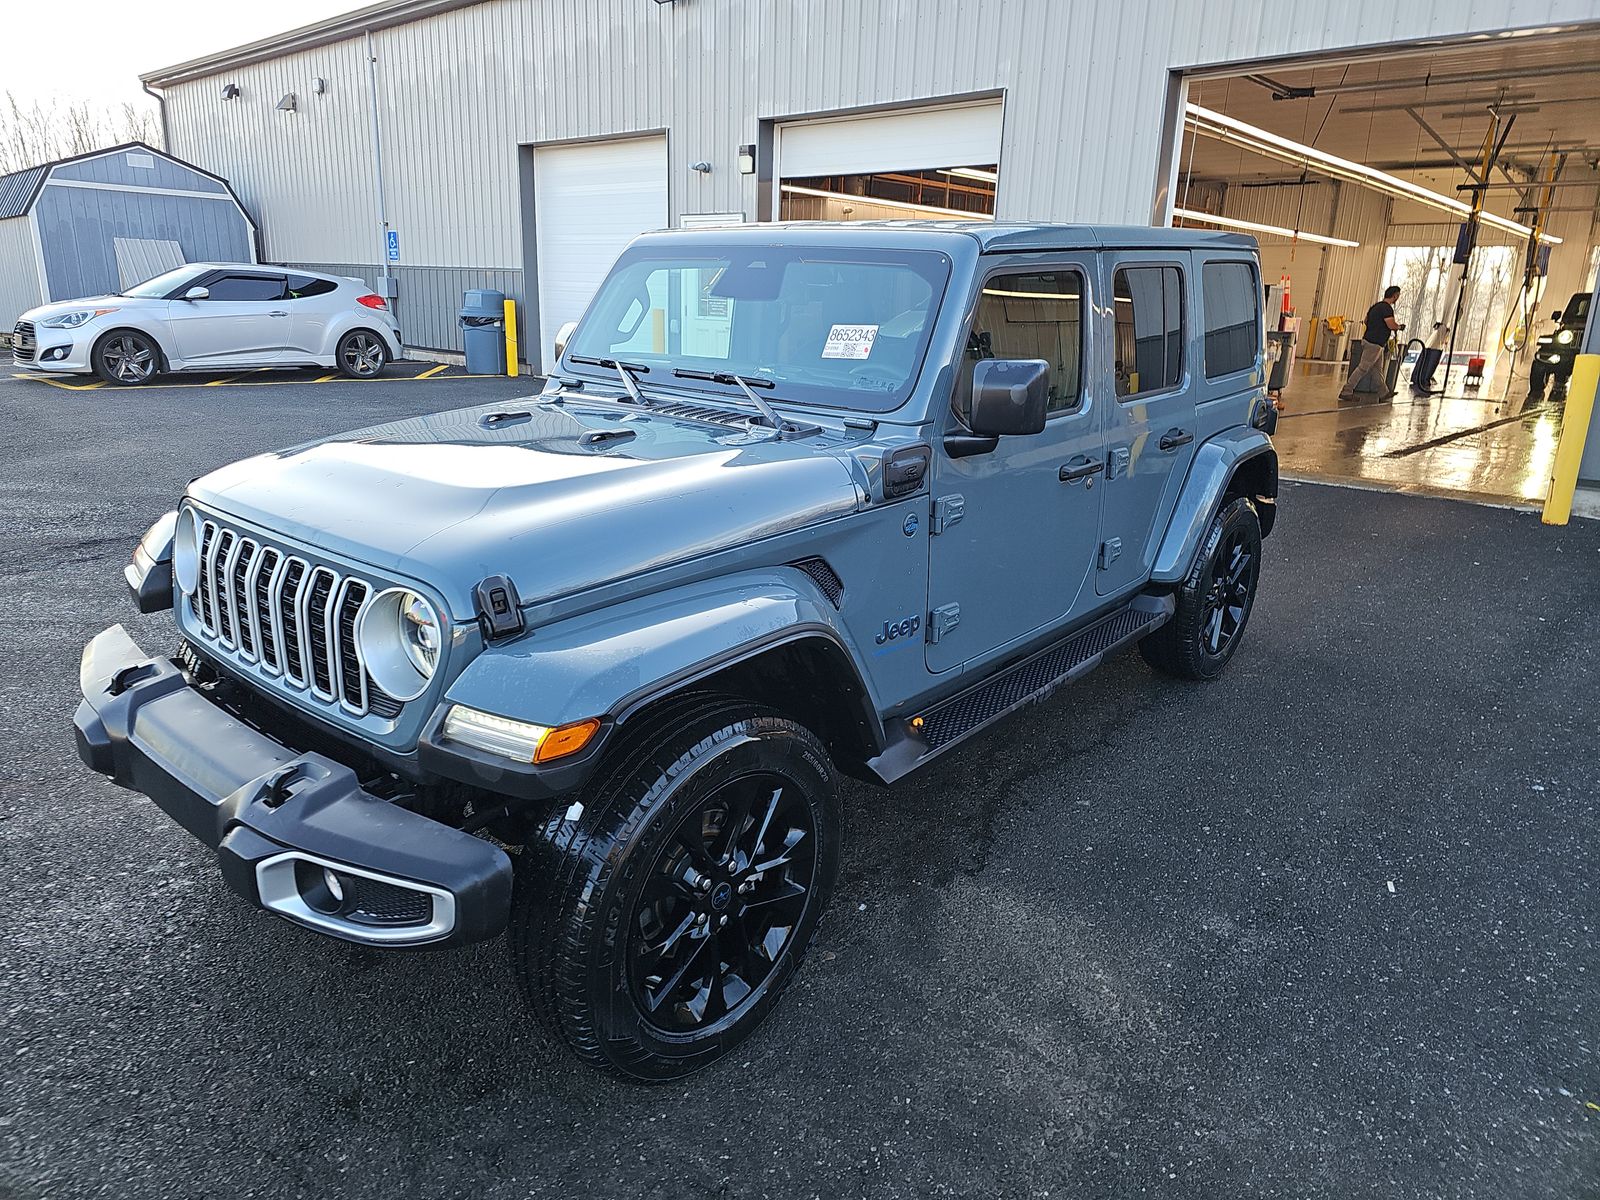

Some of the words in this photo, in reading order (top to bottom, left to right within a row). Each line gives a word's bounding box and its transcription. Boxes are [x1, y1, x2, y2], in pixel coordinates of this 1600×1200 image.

[830, 328, 877, 342] 8652343
[874, 615, 921, 645] Jeep
[801, 750, 829, 783] 255/60R20
